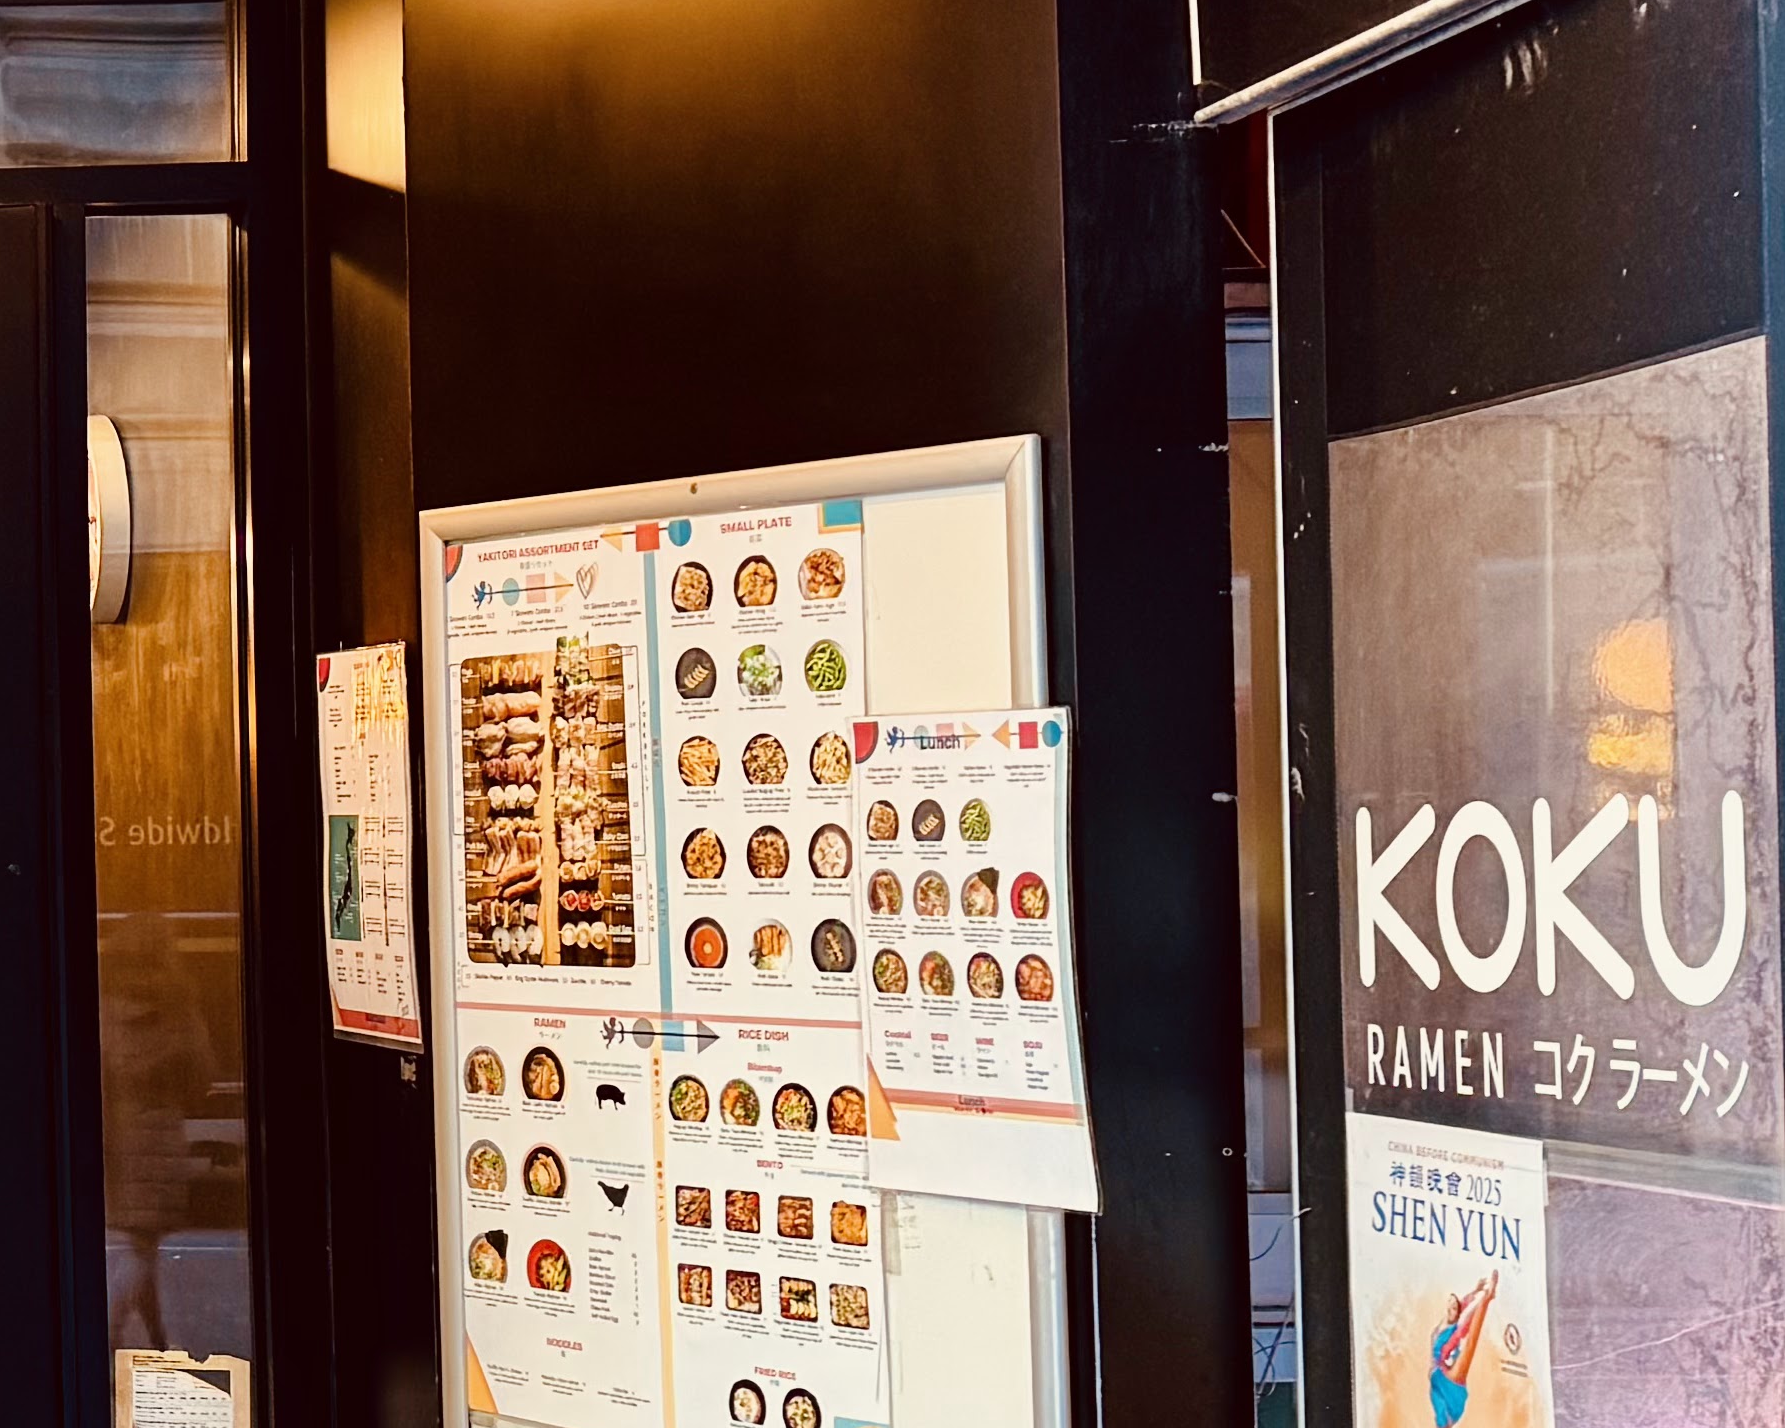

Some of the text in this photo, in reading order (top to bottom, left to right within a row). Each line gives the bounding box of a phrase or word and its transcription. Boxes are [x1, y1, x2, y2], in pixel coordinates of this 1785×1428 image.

[720, 516, 792, 534] SMALL PLATE
[477, 549, 517, 563] YAKITORI
[519, 542, 579, 558] ASSORTMENT
[920, 734, 960, 750] Lunch
[1355, 789, 1748, 1006] KOKU
[534, 1017, 566, 1029] RAMEN
[738, 1029, 789, 1041] RICE DISH
[1367, 1023, 1749, 1117] RAMEN コクラーメン
[1388, 1140, 1505, 1171] CHINA BEFORE COMMUNISM
[1465, 1173, 1502, 1207] 2025
[1372, 1190, 1522, 1262] SHEN YUN
